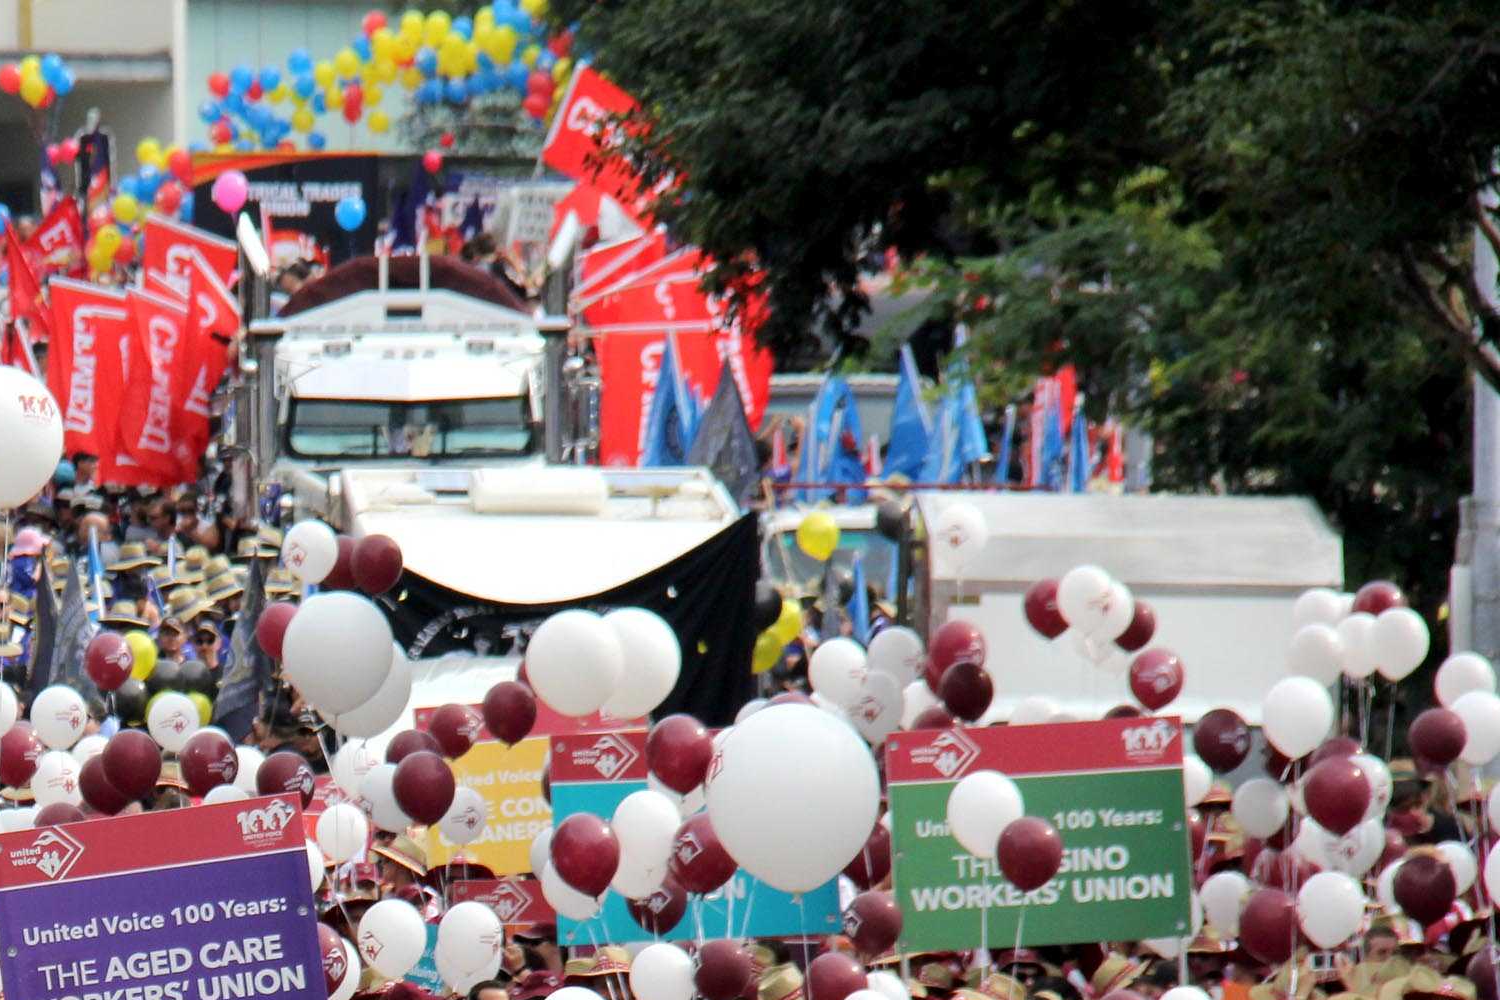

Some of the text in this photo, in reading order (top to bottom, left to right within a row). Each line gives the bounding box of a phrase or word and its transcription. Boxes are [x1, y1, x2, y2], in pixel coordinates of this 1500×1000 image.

[1053, 809, 1095, 830] 100
[10, 846, 41, 859] united
[11, 855, 38, 867] voice
[1060, 844, 1130, 873] SINO
[1071, 873, 1174, 904] UNION
[22, 896, 288, 946] United Voice 100 Years:
[37, 934, 285, 992] THE AGED CARE
